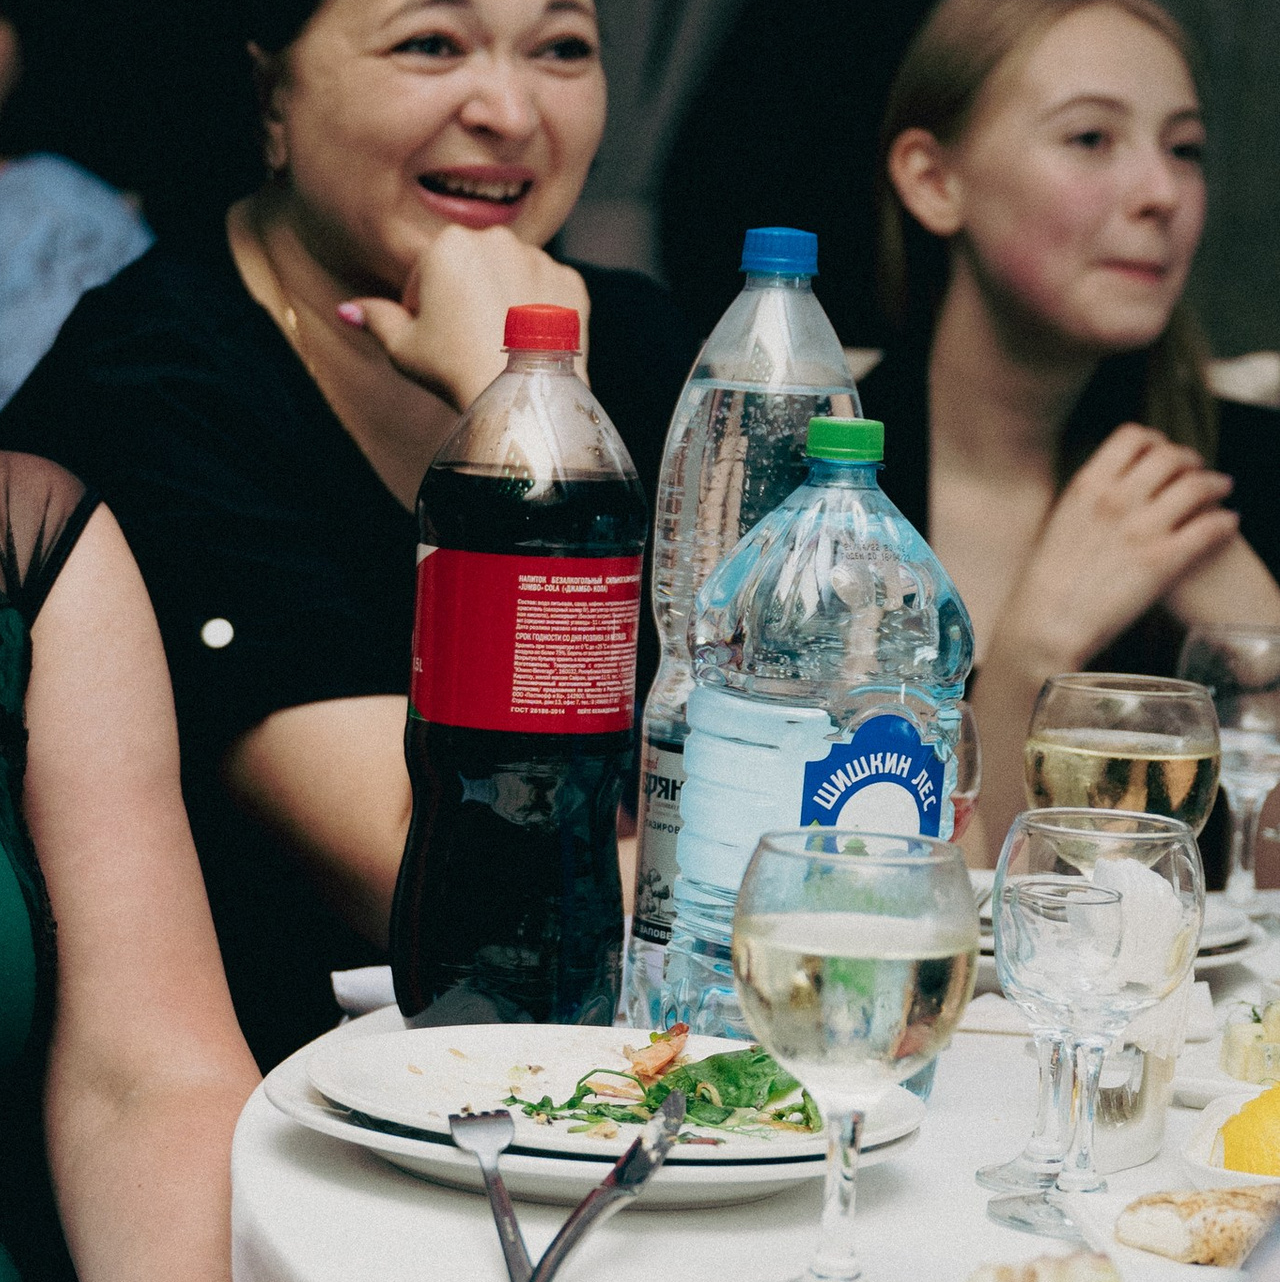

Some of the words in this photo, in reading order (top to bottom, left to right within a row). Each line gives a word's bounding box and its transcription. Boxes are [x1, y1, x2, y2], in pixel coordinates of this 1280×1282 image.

[544, 584, 560, 592] COLA
[515, 632, 531, 640] СРОК
[532, 633, 562, 641] ГОДНОСТИ
[562, 633, 571, 641] СО
[510, 706, 529, 714] ГОСТ
[812, 752, 912, 810] ШИШКИН
[910, 768, 937, 812] ЛЕС
